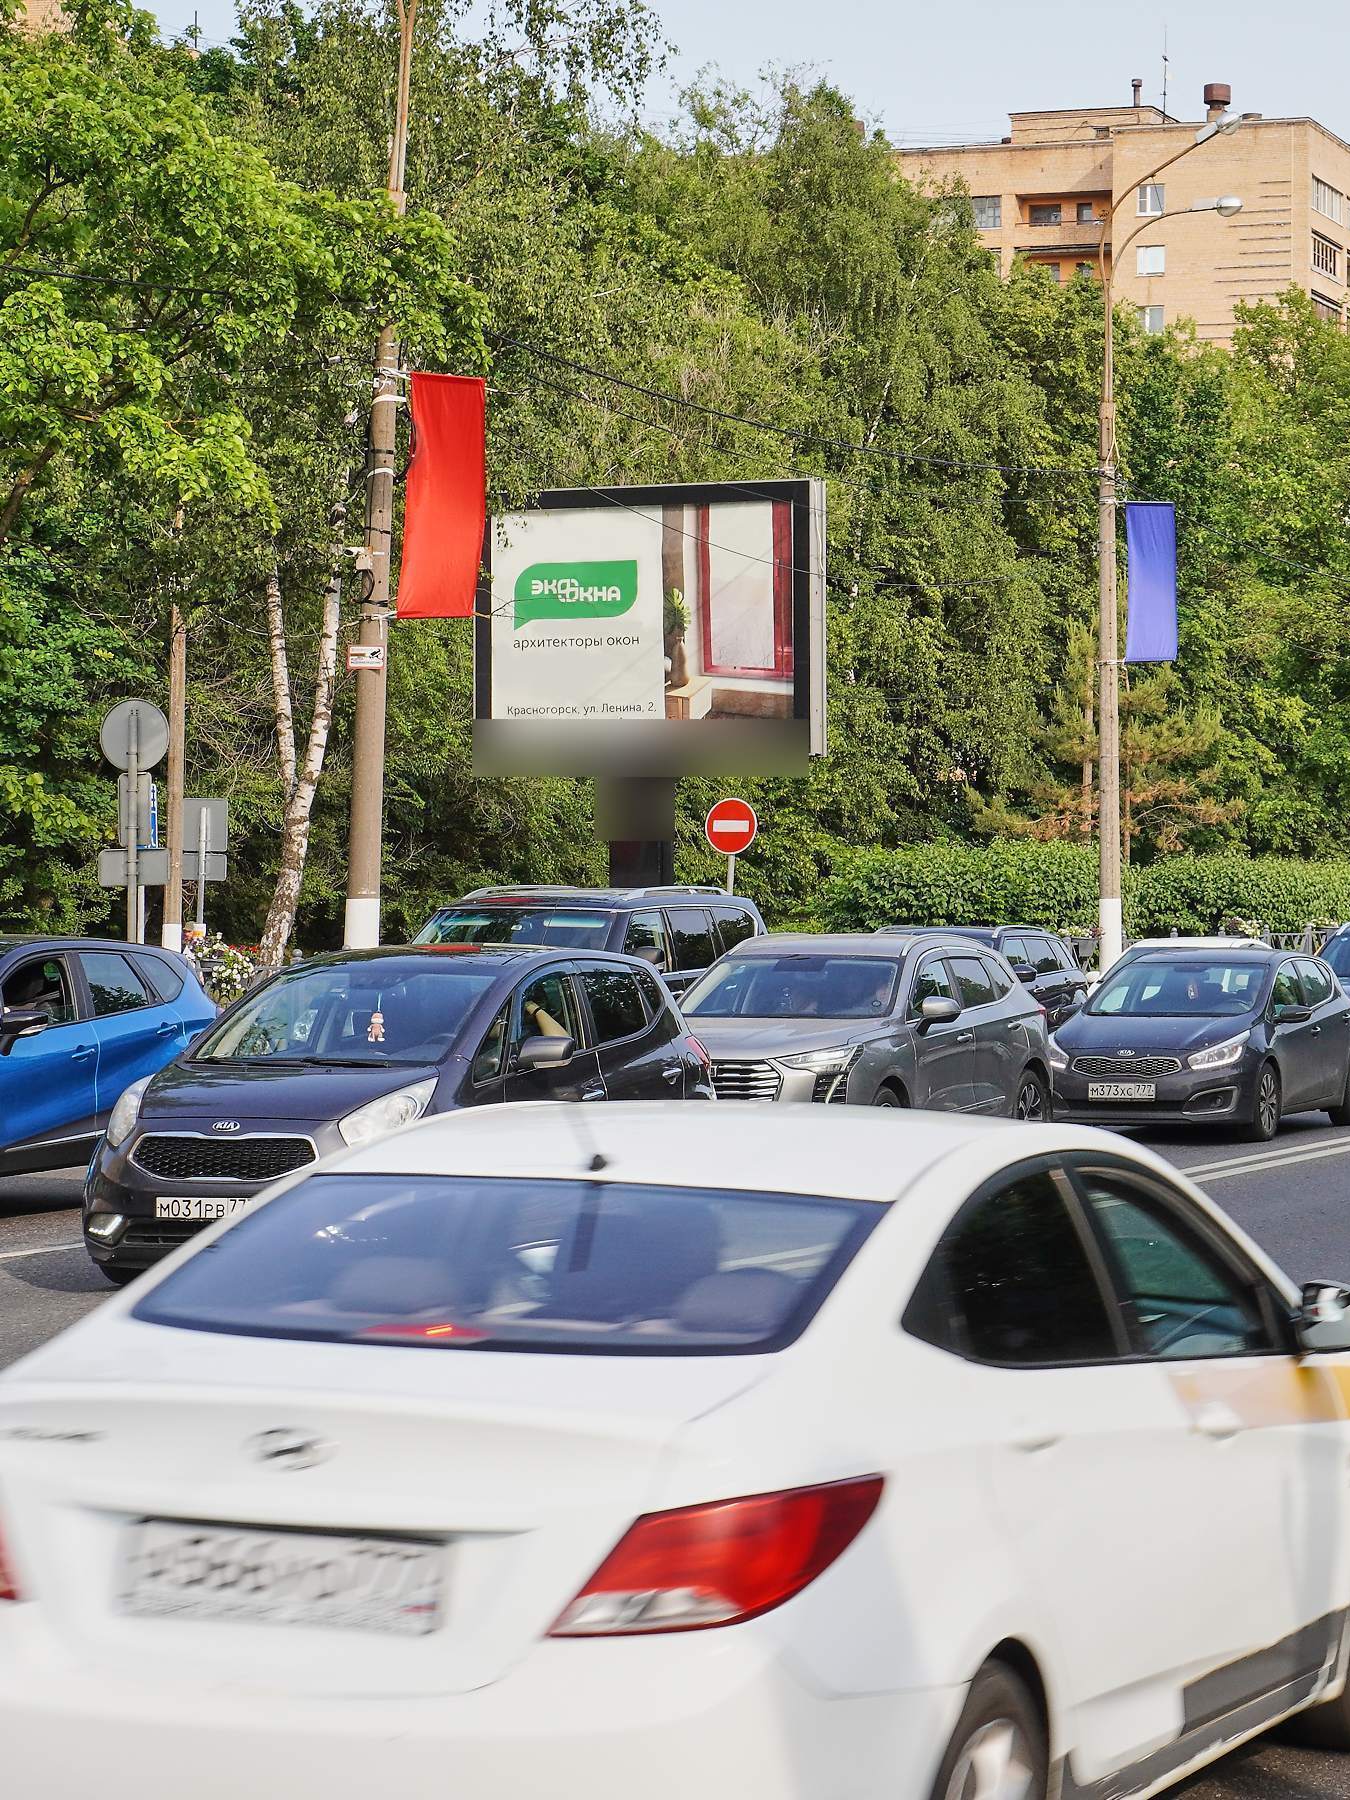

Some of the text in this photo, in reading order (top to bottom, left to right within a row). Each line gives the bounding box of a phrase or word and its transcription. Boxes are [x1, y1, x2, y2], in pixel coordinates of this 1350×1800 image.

[513, 635, 640, 651] архитекторы окон
[507, 701, 657, 717] Красногорск, ул. Ленина, 2,
[214, 1120, 237, 1130] KIA
